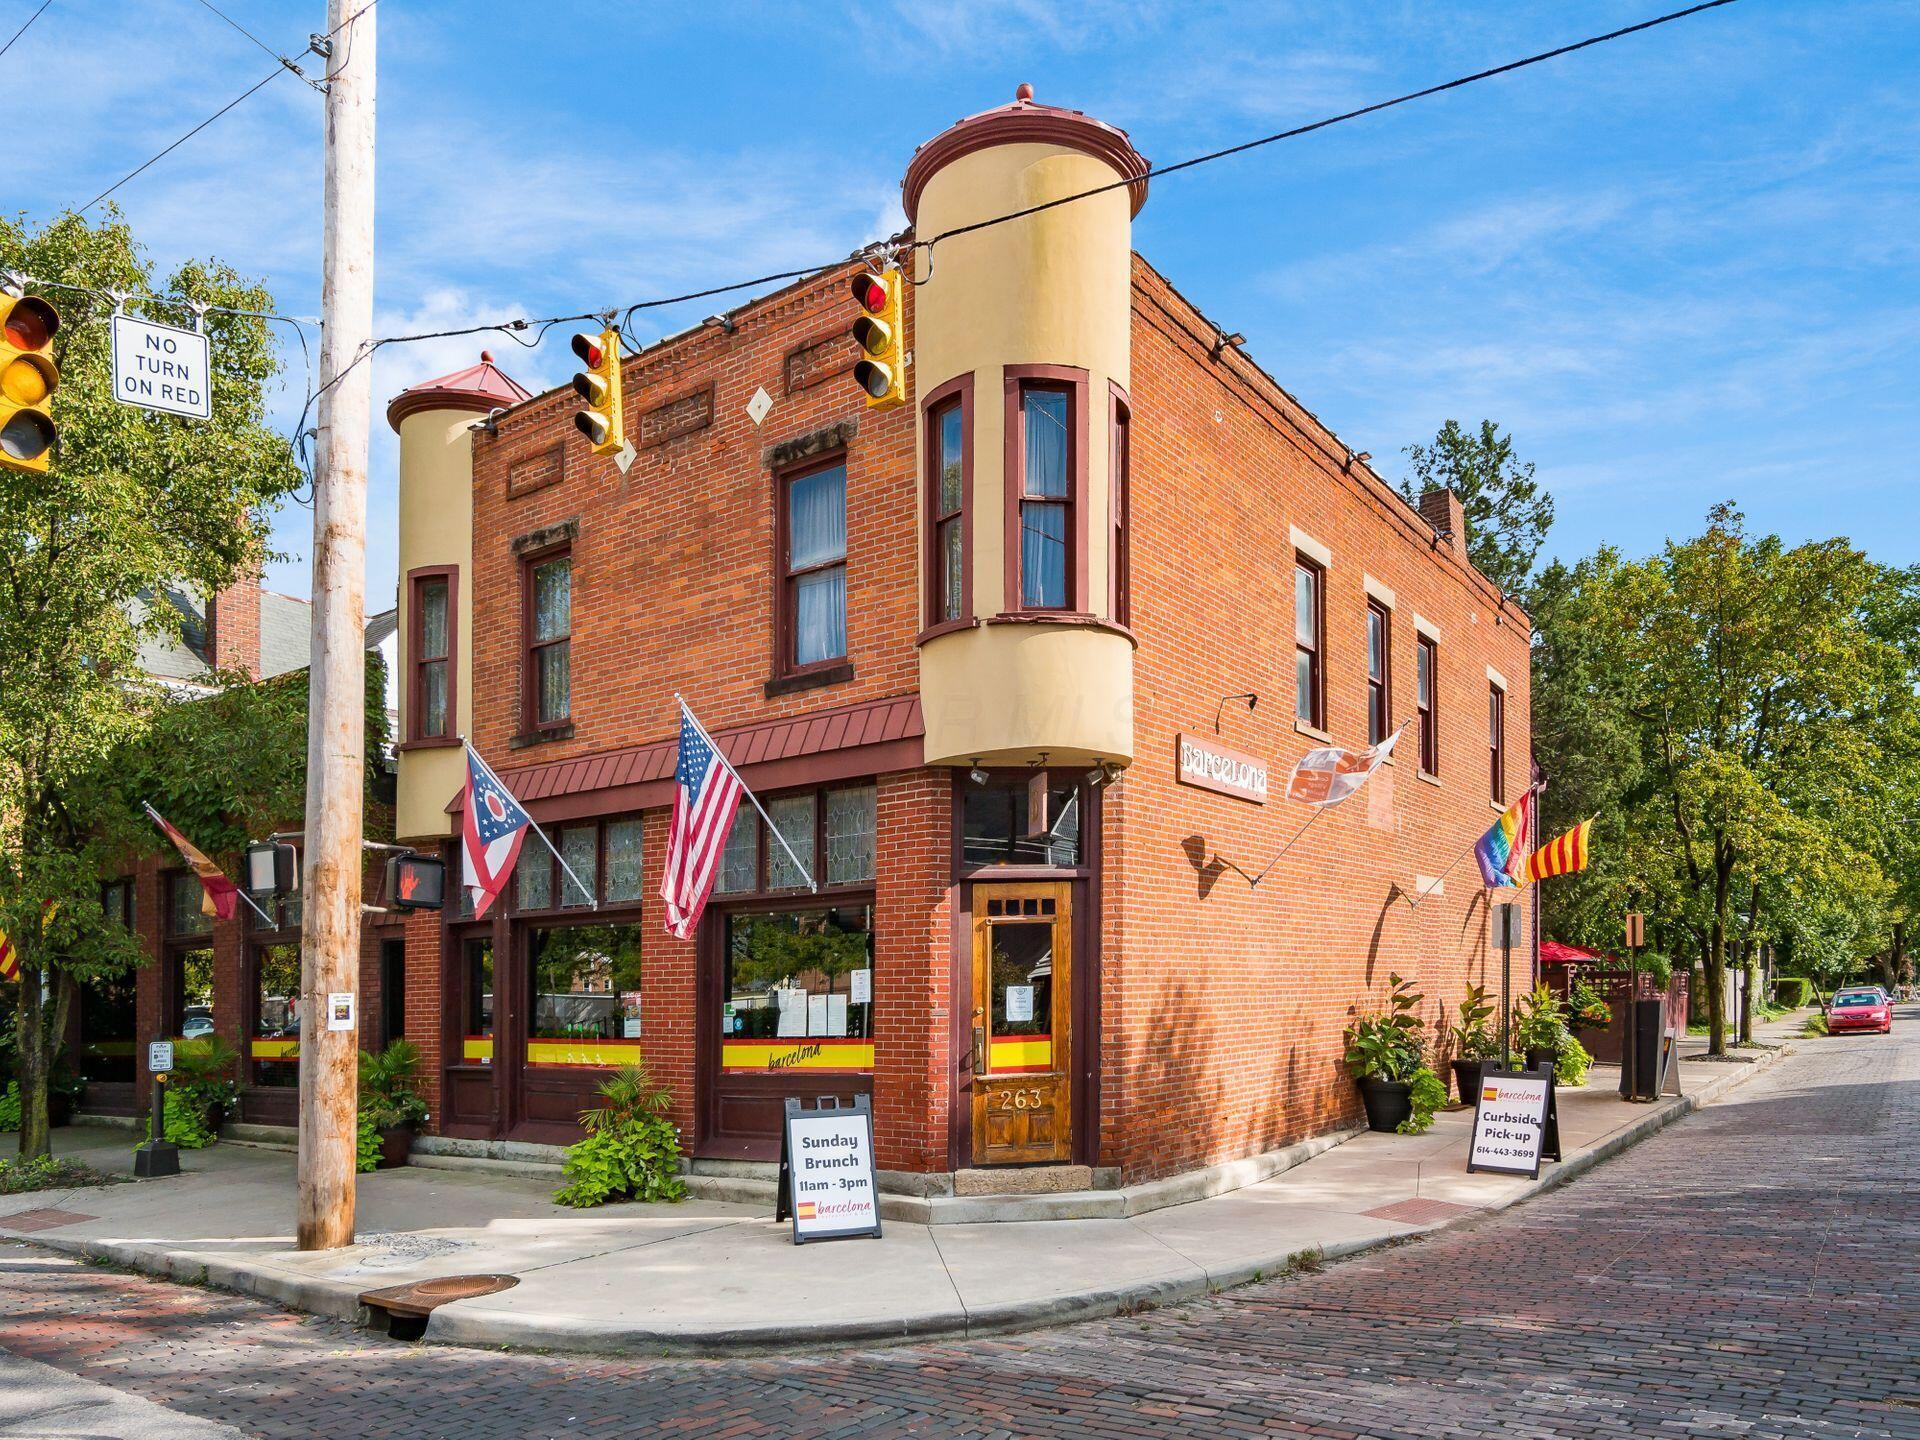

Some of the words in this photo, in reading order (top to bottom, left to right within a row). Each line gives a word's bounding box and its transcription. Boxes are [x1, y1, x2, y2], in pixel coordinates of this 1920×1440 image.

[146, 333, 177, 354] NO
[135, 354, 189, 381] TURN
[125, 376, 152, 396] ON
[162, 383, 200, 406] RED
[768, 1043, 822, 1072] barcelona
[1000, 1089, 1042, 1110] 263
[1497, 1088, 1542, 1102] barcelona
[1483, 1111, 1537, 1125] Curbside
[802, 1134, 858, 1149] Sunday
[1484, 1128, 1531, 1143] Pick-up
[1476, 1145, 1535, 1158] 614-443-3699
[805, 1153, 859, 1170] Brunch
[799, 1180, 829, 1192] 11am
[838, 1177, 868, 1192] 3pm
[817, 1199, 873, 1215] barcelona
